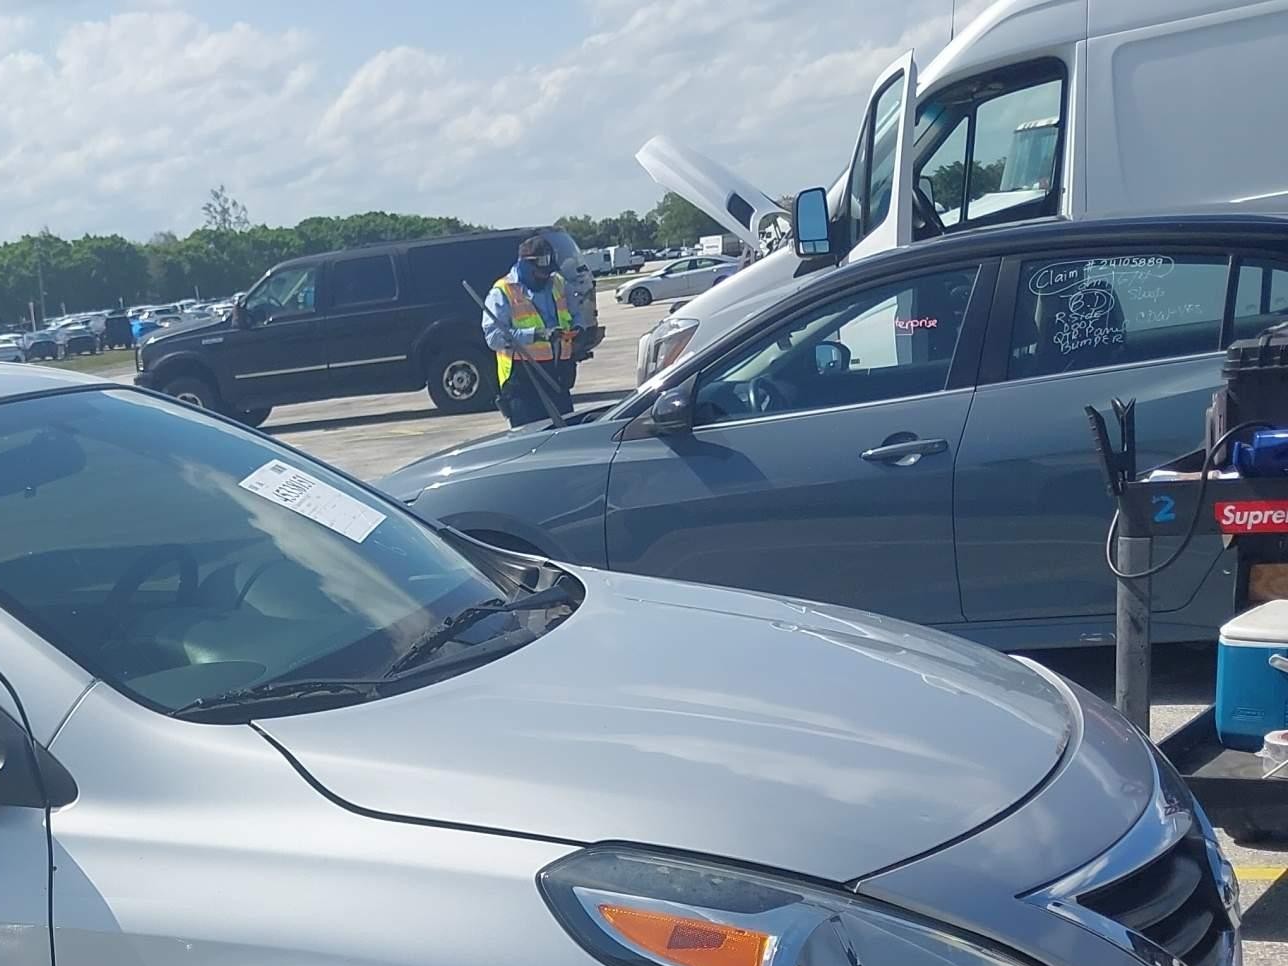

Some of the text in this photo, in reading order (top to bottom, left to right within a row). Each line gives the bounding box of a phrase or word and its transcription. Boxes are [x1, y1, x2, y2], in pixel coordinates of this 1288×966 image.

[1036, 269, 1079, 289] Claim
[1151, 495, 1177, 523] 2
[1221, 504, 1288, 531] Supre
